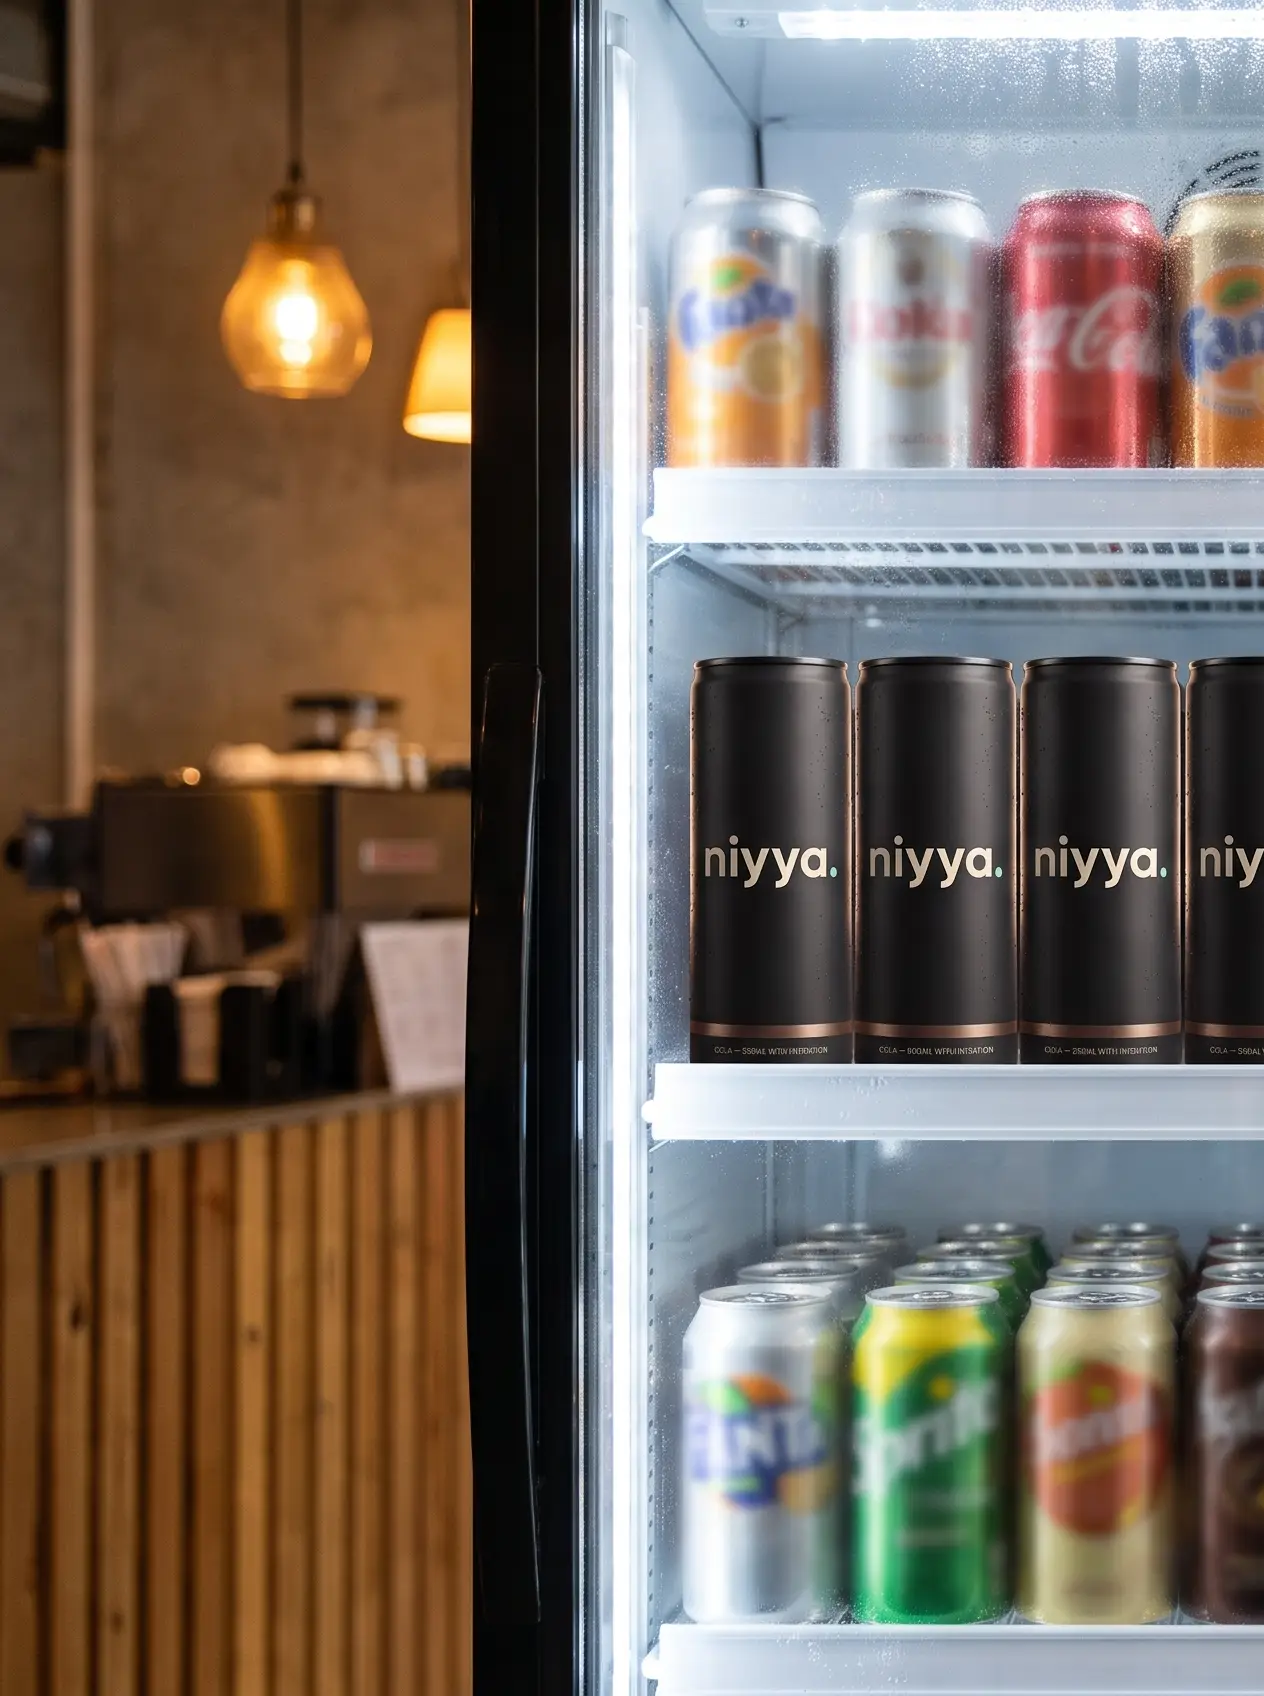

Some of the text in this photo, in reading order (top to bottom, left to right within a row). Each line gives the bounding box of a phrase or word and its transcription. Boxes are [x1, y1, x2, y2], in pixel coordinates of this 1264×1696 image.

[705, 835, 837, 888] niyya.
[870, 835, 1002, 888] niyya.
[1035, 835, 1167, 888] niyya.
